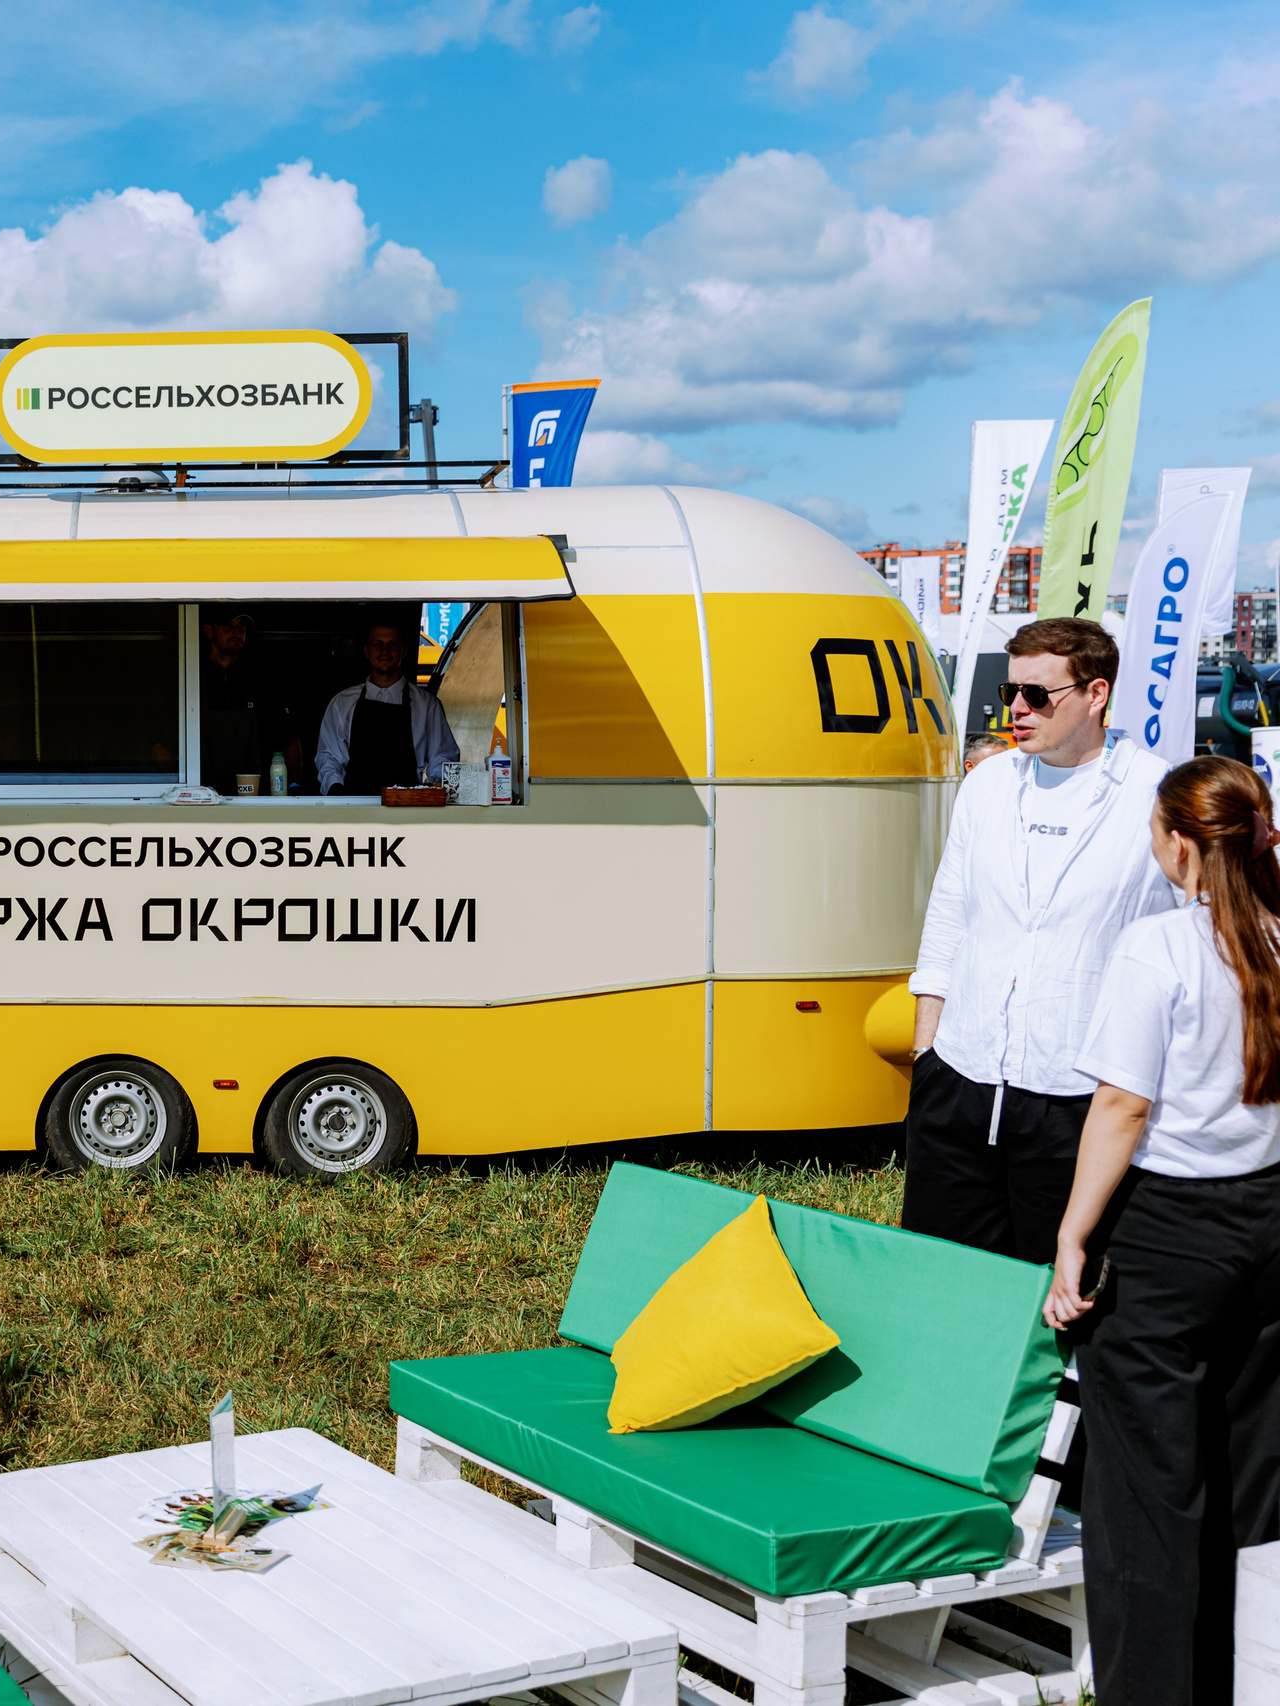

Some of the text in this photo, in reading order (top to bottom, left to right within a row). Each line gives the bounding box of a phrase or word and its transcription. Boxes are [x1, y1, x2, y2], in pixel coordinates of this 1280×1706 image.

[48, 382, 345, 410] РОССЕЛЬХОЗБАНК
[810, 637, 954, 735] ОК
[142, 897, 477, 943] ОКРОШКИ
